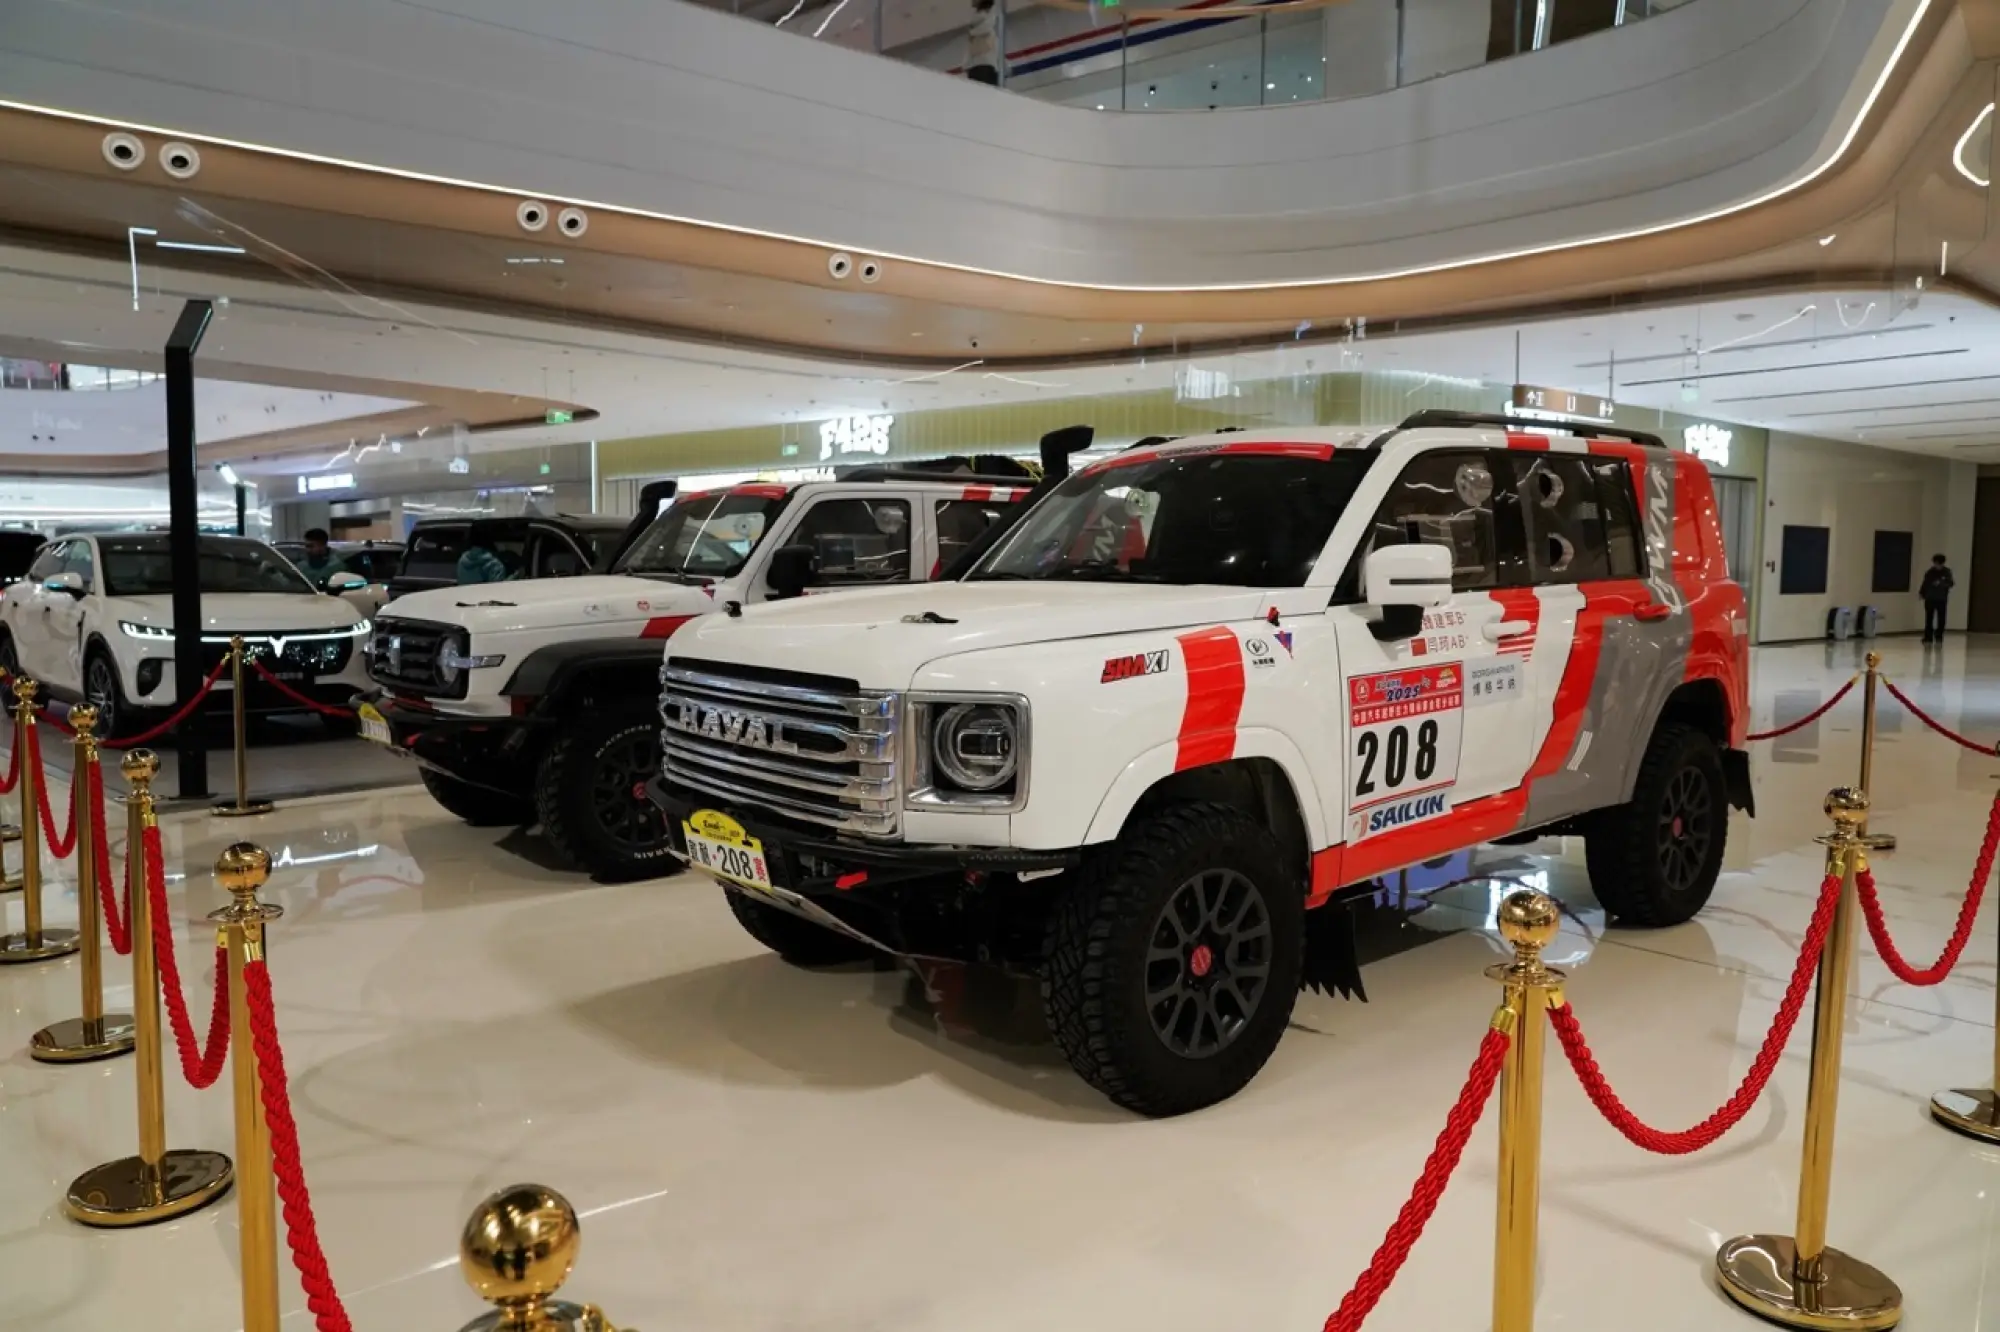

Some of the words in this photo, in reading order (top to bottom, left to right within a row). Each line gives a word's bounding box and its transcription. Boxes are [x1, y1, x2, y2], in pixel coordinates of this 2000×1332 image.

[678, 703, 798, 753] HAVAL
[1356, 719, 1438, 796] 208
[1369, 793, 1445, 831] SAILUN
[716, 844, 754, 880] 208
